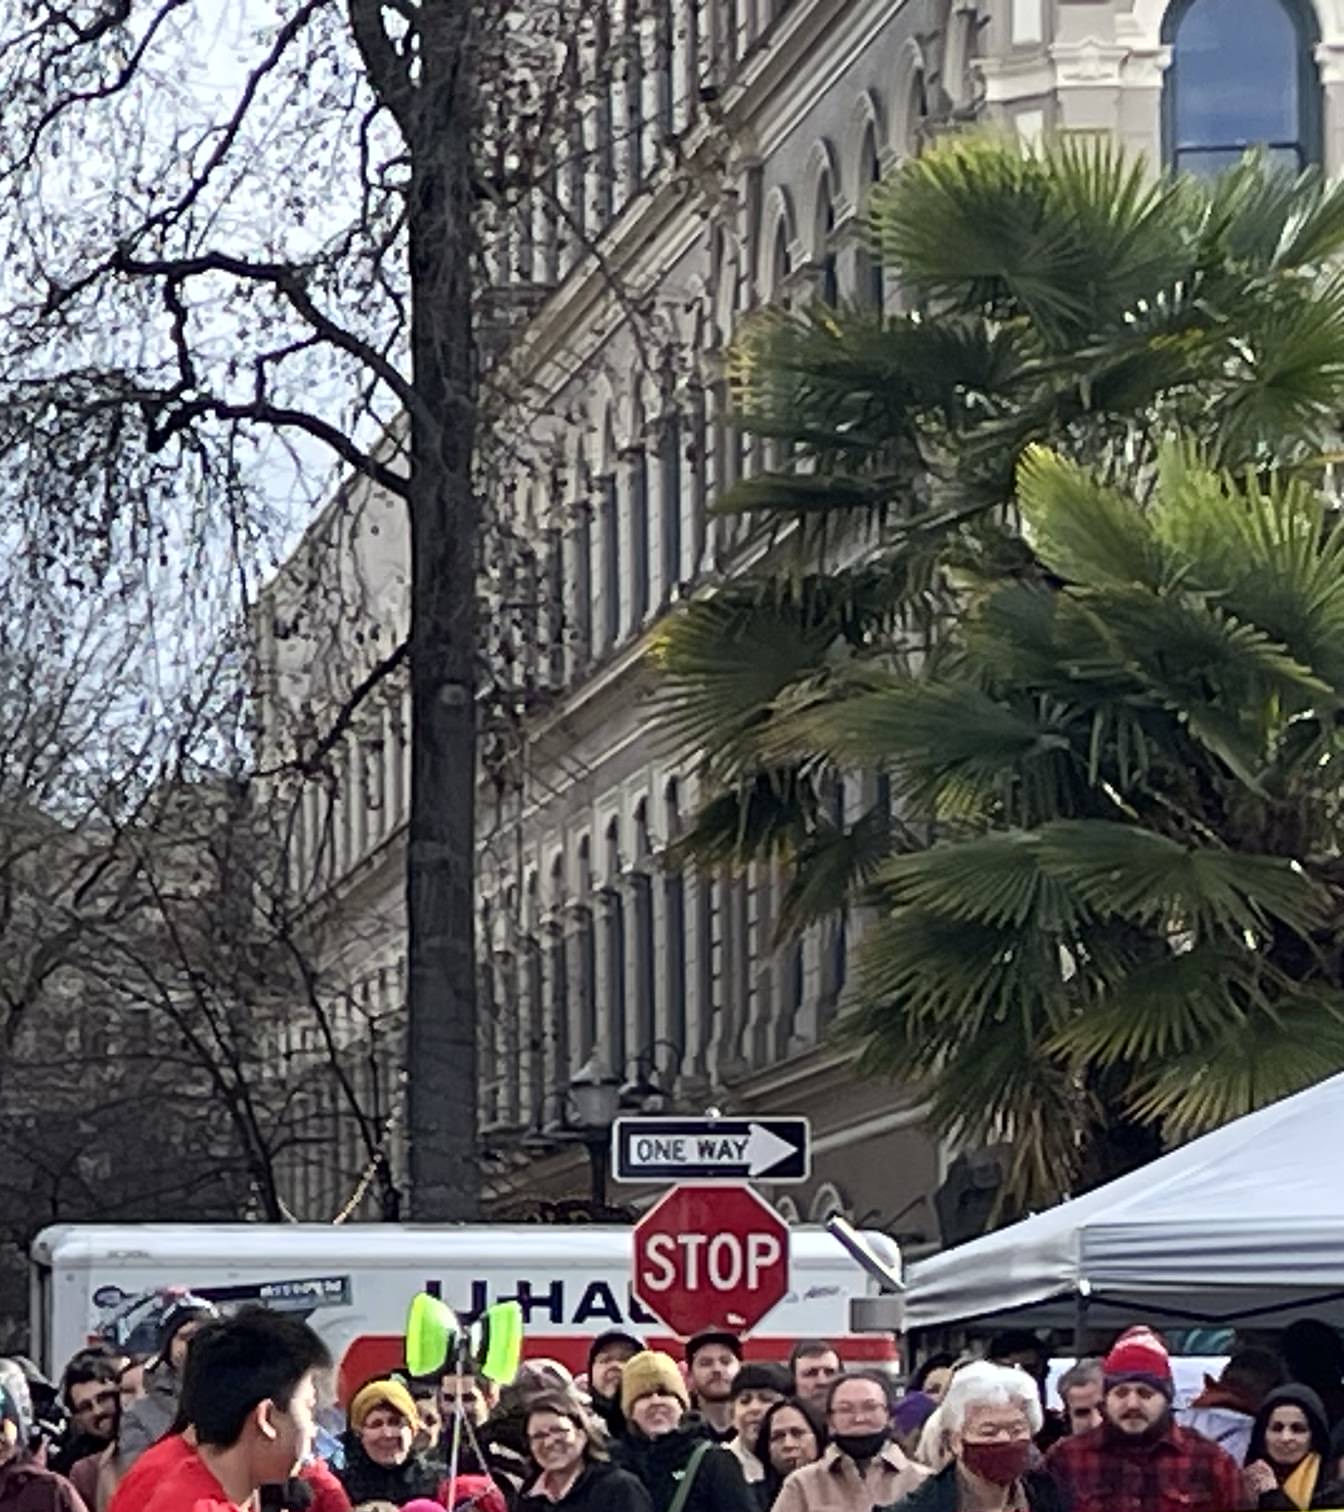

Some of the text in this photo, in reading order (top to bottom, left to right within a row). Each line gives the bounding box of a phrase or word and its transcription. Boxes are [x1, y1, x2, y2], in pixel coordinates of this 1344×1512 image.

[636, 1139, 748, 1162] ONE WAY
[643, 1233, 782, 1291] STOP
